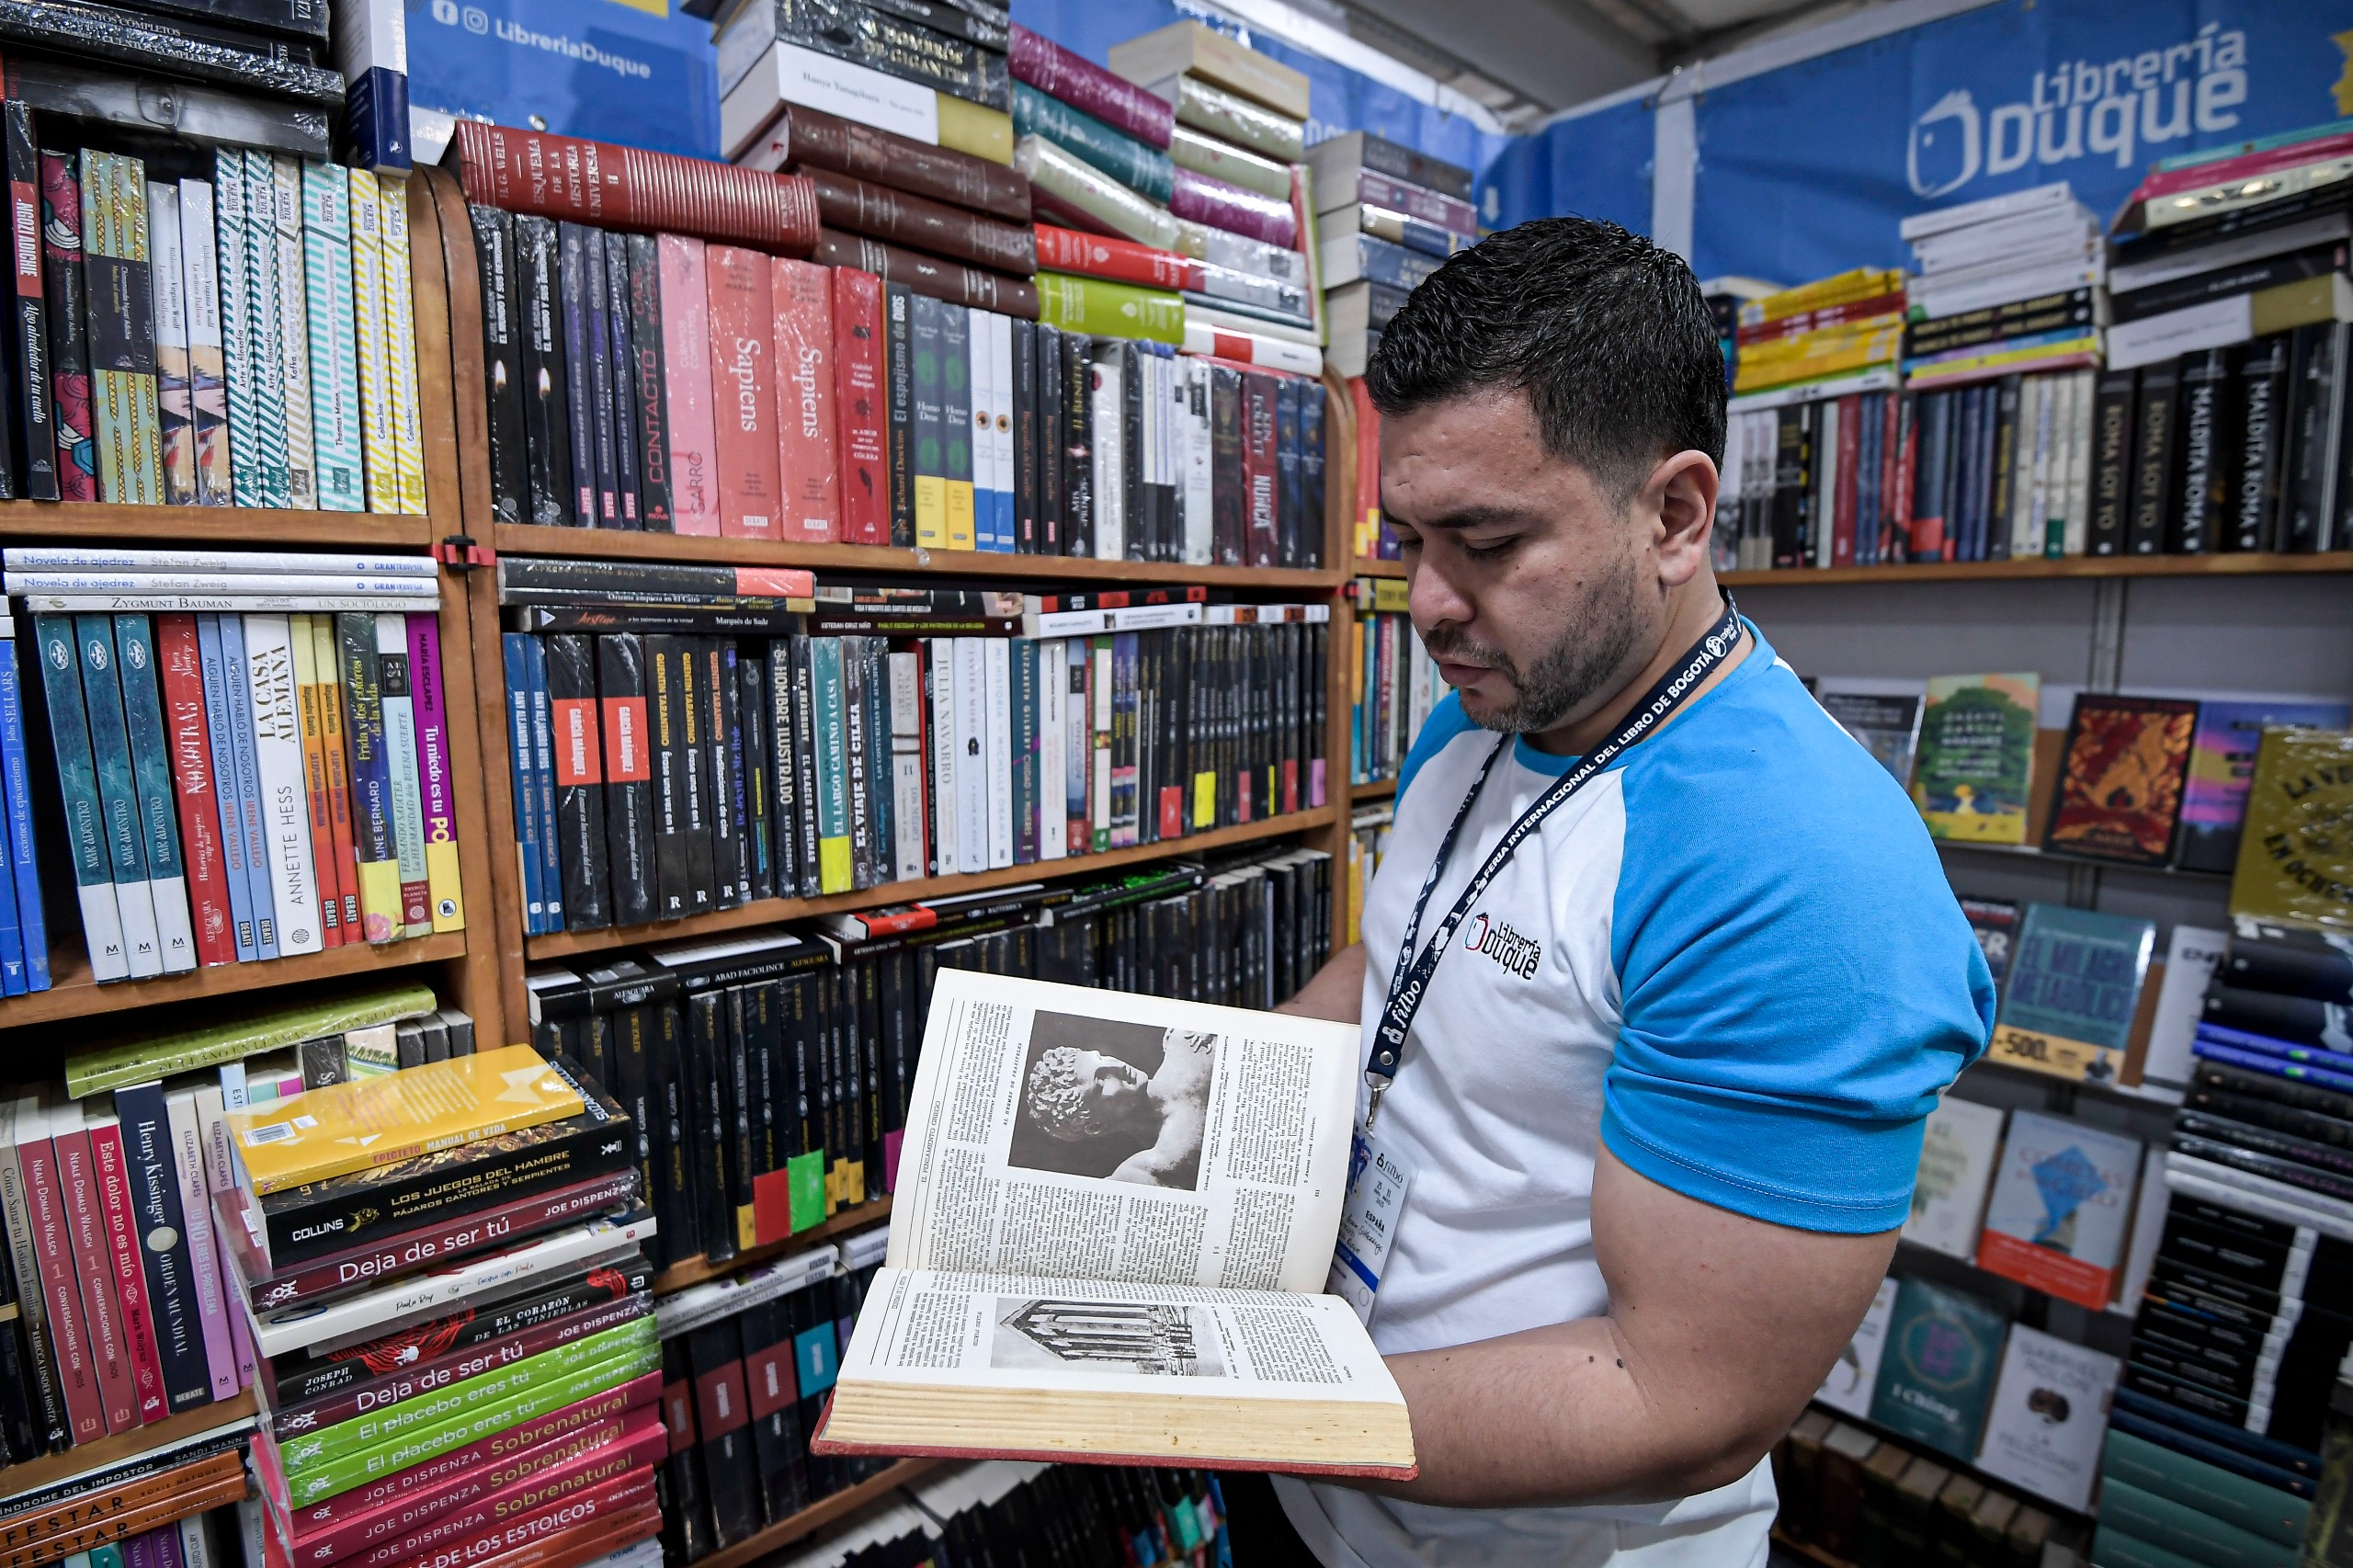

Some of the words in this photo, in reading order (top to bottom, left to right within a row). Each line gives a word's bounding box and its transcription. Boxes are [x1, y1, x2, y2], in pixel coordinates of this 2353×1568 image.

[496, 18, 651, 78] LibreriaDuque
[1988, 69, 2247, 175] Duque
[494, 132, 506, 169] WELLS
[551, 153, 560, 169] LA
[529, 139, 546, 204] ESQUEMA
[553, 176, 562, 194] DE
[566, 145, 582, 207] HISTORIA
[585, 143, 601, 217] UNIVERSAL
[16, 201, 35, 235] NGOZI
[18, 236, 37, 277] ADICHIE
[25, 301, 40, 324] Algo
[892, 295, 905, 322] DIOS
[26, 324, 41, 370] alrededor
[892, 323, 906, 337] de
[30, 371, 40, 382] de
[729, 337, 761, 432] Sapiens
[892, 339, 907, 405] espejismo
[33, 395, 47, 424] cuello
[792, 348, 823, 438] Sapiens
[916, 402, 940, 413] Homo
[642, 349, 664, 483] CONTACTO
[894, 408, 907, 422] El
[920, 410, 939, 422] Deus
[24, 578, 69, 587] Novela
[73, 579, 87, 587] de
[91, 578, 135, 589] ajedrez
[152, 579, 189, 588] Stefan
[193, 580, 227, 590] Zweig
[111, 597, 174, 608] ZYGMUNT
[179, 598, 233, 608] BAUMAN
[716, 616, 744, 627] Marqués
[754, 618, 768, 626] Sade
[2, 671, 17, 721] SELLARS
[252, 653, 272, 706] CASA
[270, 645, 296, 744] ALEMANA
[774, 665, 790, 723] HOMBRE
[827, 678, 838, 709] CASA
[936, 658, 949, 705] JULIA
[7, 723, 18, 742] John
[259, 711, 276, 739] LA
[425, 725, 439, 745] Tu
[426, 744, 441, 781] miedo
[830, 722, 840, 771] CAMINO
[938, 710, 952, 784] NAVARRO
[778, 727, 793, 805] ILUSTRADO
[1483, 846, 1509, 879] FERIA
[1507, 763, 1597, 846] INTERNACIONAL
[1594, 744, 1620, 765] DEL
[1618, 712, 1654, 745] LIBRO
[1651, 695, 1672, 715] DE
[1666, 651, 1713, 699] BOGOTÁ
[278, 786, 295, 825] HESS
[430, 784, 441, 798] es
[832, 774, 843, 816] LARGO
[15, 810, 25, 822] de
[246, 801, 257, 828] IRENE
[835, 818, 844, 834] EL
[16, 824, 30, 865] Lecciones
[251, 829, 263, 868] VALLEJO
[282, 833, 304, 904] ANNETTE
[324, 900, 337, 928] DEBATE
[715, 970, 737, 983] ABAD
[738, 961, 785, 978] FACIOLINCE
[1482, 929, 1538, 981] Duque
[1392, 981, 1421, 1029] filbo
[576, 1086, 609, 1120] SUZANNE
[100, 1141, 115, 1172] Este
[138, 1119, 156, 1162] Henry
[372, 1144, 421, 1164] EPICTETO
[426, 1134, 466, 1151] MANUAL
[469, 1130, 481, 1141] DE
[483, 1123, 506, 1137] VIDA
[923, 1128, 936, 1174] PENSAMIENTO
[3, 1167, 15, 1197] Cómo
[70, 1152, 81, 1178] NEALE
[392, 1191, 421, 1206] LOS
[425, 1175, 482, 1198] JUEGOS
[485, 1167, 513, 1182] DEL
[515, 1150, 570, 1173] HAMBRE
[922, 1175, 926, 1183] EL
[74, 1179, 86, 1212] DONALD
[107, 1175, 122, 1210] dolor
[146, 1163, 166, 1224] Kissinger
[393, 1198, 443, 1218] PÁJAROS
[445, 1185, 500, 1204] CANTORES
[511, 1163, 571, 1186] SERPIENTES
[7, 1199, 20, 1224] Sanar
[113, 1214, 125, 1232] no
[1365, 1210, 1385, 1233] ESPAÑA
[15, 1225, 22, 1237] tu
[81, 1214, 93, 1248] WALSCH
[117, 1234, 128, 1249] es
[292, 1218, 344, 1243] COLLINS
[339, 1256, 396, 1283] Deja
[405, 1243, 437, 1262] de
[443, 1231, 480, 1252] ser
[487, 1217, 510, 1237] tú
[544, 1203, 568, 1218] JOE
[17, 1239, 29, 1275] Historia
[119, 1253, 133, 1277] mío
[160, 1254, 176, 1294] ORDEN
[23, 1276, 37, 1316] Familiar
[495, 1315, 513, 1328] EL
[516, 1296, 571, 1321] CORAZÓN
[167, 1297, 188, 1357] MUNDIAL
[474, 1333, 491, 1343] DE
[496, 1324, 520, 1335] LAS
[527, 1301, 589, 1325] TINIEBLAS
[176, 1387, 205, 1403] DEBATE
[304, 1374, 353, 1395] CONRAD
[305, 1367, 349, 1388] JOSEPH
[359, 1425, 378, 1439] El
[383, 1396, 461, 1434] placebo
[468, 1381, 506, 1402] eres
[511, 1369, 530, 1385] tú
[176, 1448, 209, 1462] SANDI
[212, 1436, 243, 1452] MANN
[364, 1482, 395, 1502] JOE
[403, 1451, 482, 1487] DISPENZA
[491, 1392, 628, 1456] Sobrenatural
[63, 1483, 87, 1496] DEL
[92, 1464, 153, 1486] IMPOSTOR
[435, 1551, 462, 1568] DE
[466, 1535, 502, 1557] LOS
[506, 1499, 596, 1544] ESTOICOS
